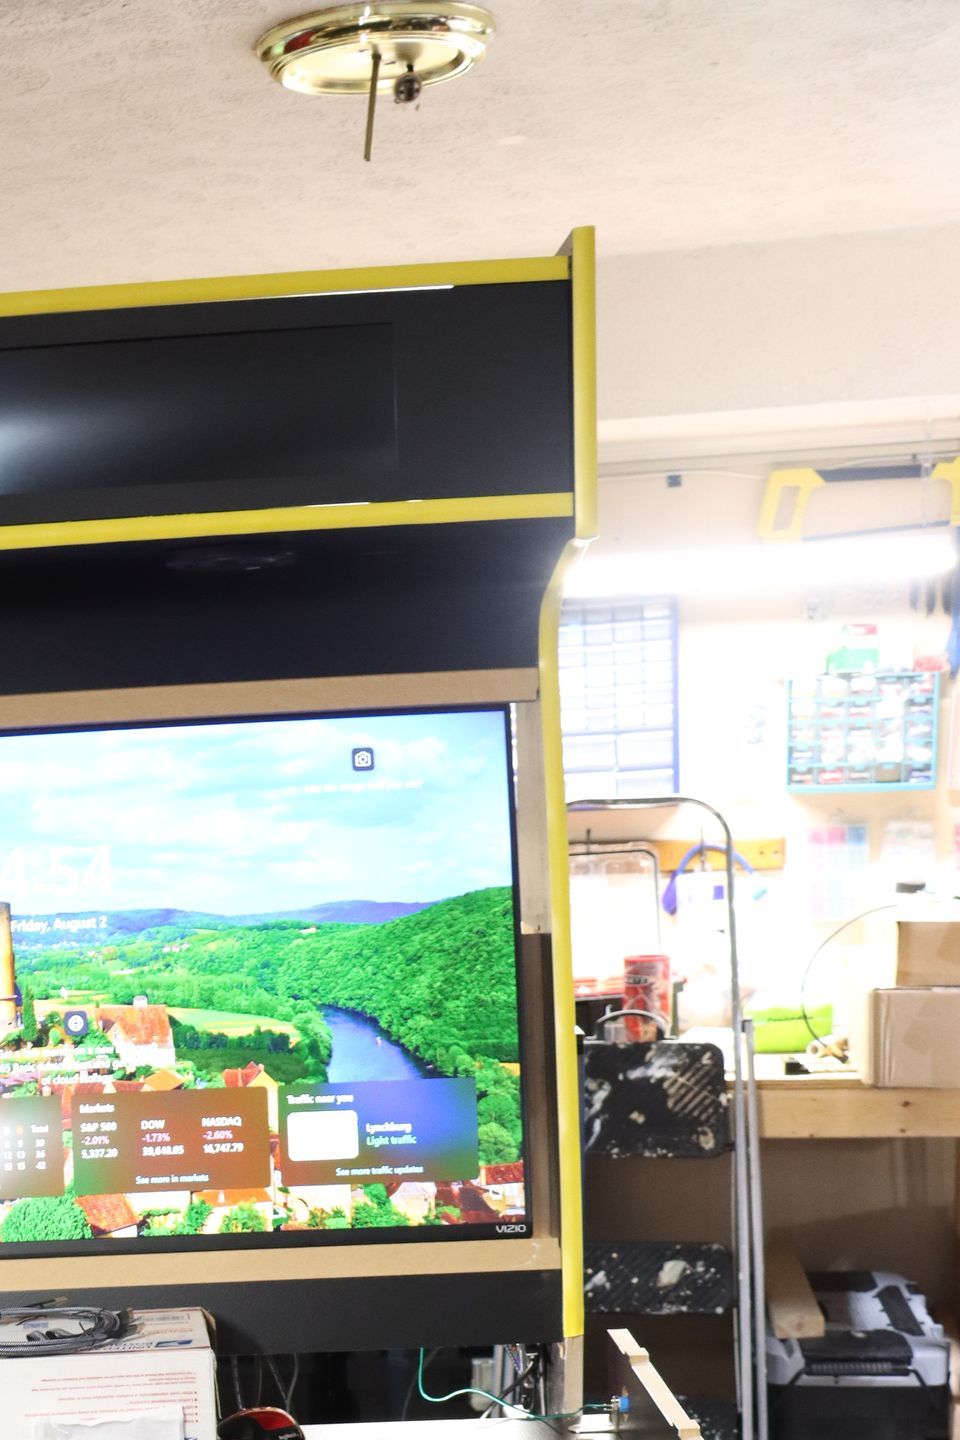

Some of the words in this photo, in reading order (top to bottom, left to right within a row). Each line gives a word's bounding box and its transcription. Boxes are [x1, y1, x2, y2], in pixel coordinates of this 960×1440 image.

[10, 918, 51, 934] Friday,
[53, 917, 97, 932] August
[98, 915, 108, 928] 2
[287, 1094, 314, 1104] Traffic
[315, 1095, 336, 1104] near
[336, 1094, 354, 1105] you
[79, 1103, 115, 1113] Markets
[80, 1122, 99, 1132] S&P
[141, 1119, 165, 1130] DOW
[201, 1116, 242, 1128] NASDAQ
[365, 1122, 412, 1134] Lynchburg
[81, 1135, 110, 1145] -2.01%
[142, 1132, 171, 1142] -1.73%
[202, 1129, 233, 1140] -2.60%
[366, 1135, 390, 1147] Light
[391, 1134, 417, 1145] traffic
[335, 1167, 350, 1176] See
[351, 1167, 371, 1176] more
[371, 1165, 393, 1175] traffic
[394, 1165, 424, 1175] updates
[135, 1175, 150, 1184] See
[151, 1175, 170, 1184] more
[171, 1174, 179, 1183] in
[180, 1173, 209, 1183] markets
[495, 1224, 527, 1233] VIZIO
